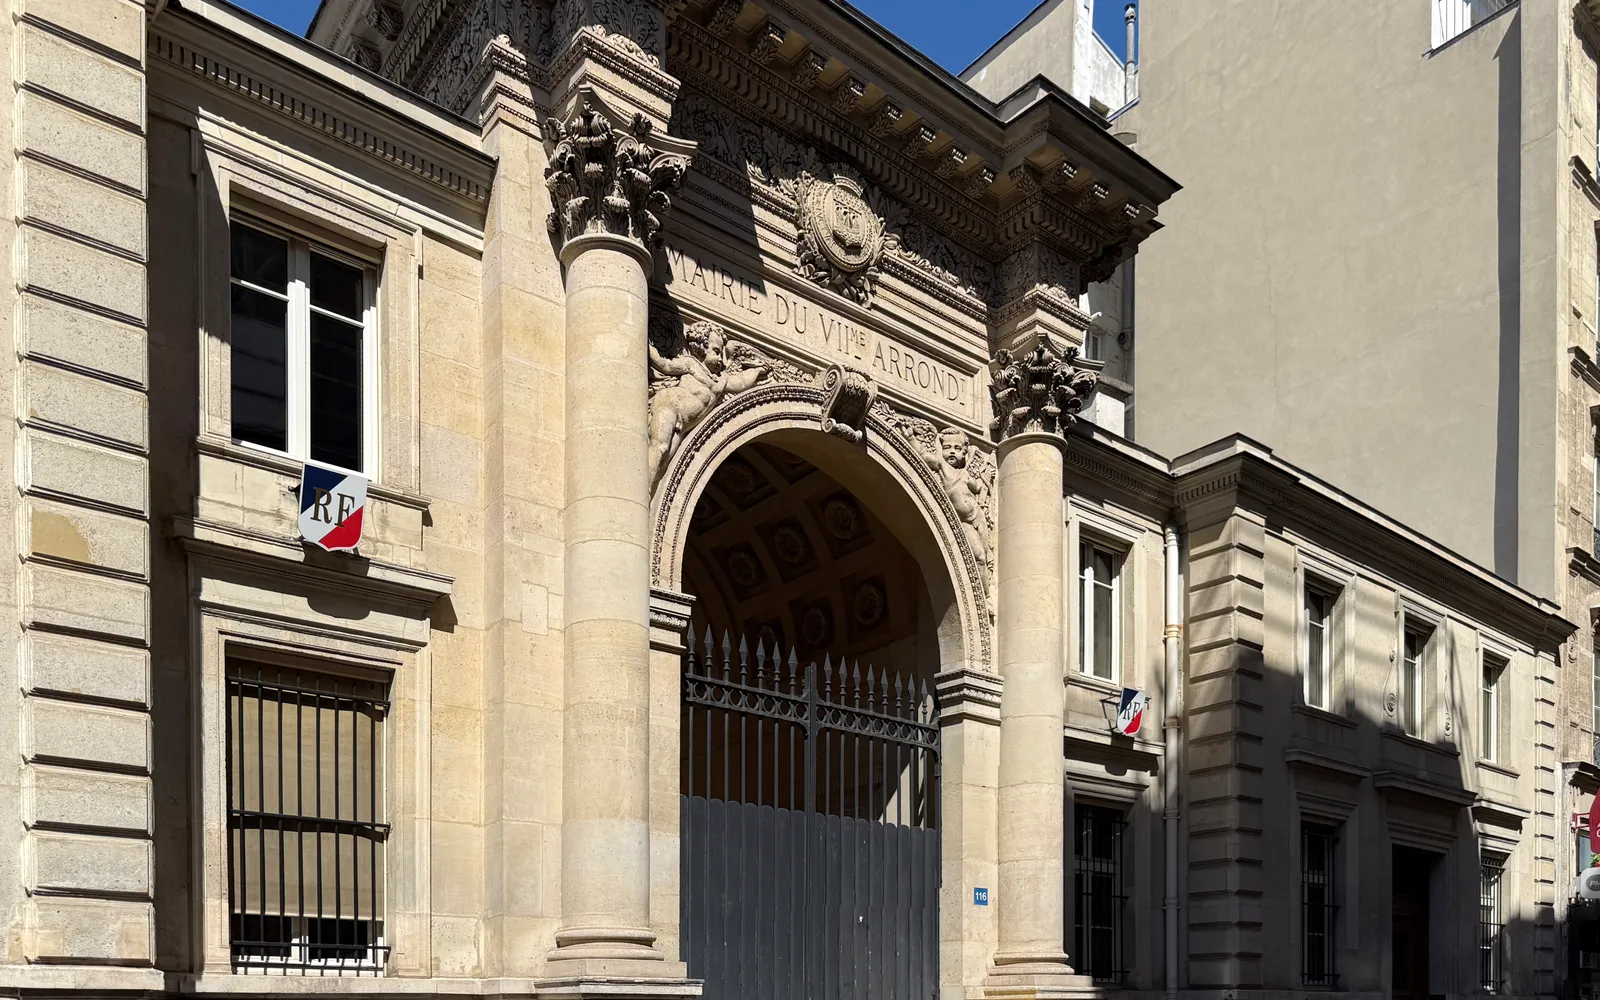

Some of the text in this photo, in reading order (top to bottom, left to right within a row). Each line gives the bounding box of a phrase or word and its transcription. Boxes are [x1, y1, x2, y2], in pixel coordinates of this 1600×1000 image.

[665, 244, 762, 315] MAIRIE
[773, 292, 807, 334] DU
[310, 486, 355, 528] RF
[1122, 701, 1141, 721] RF
[975, 891, 987, 901] 116
